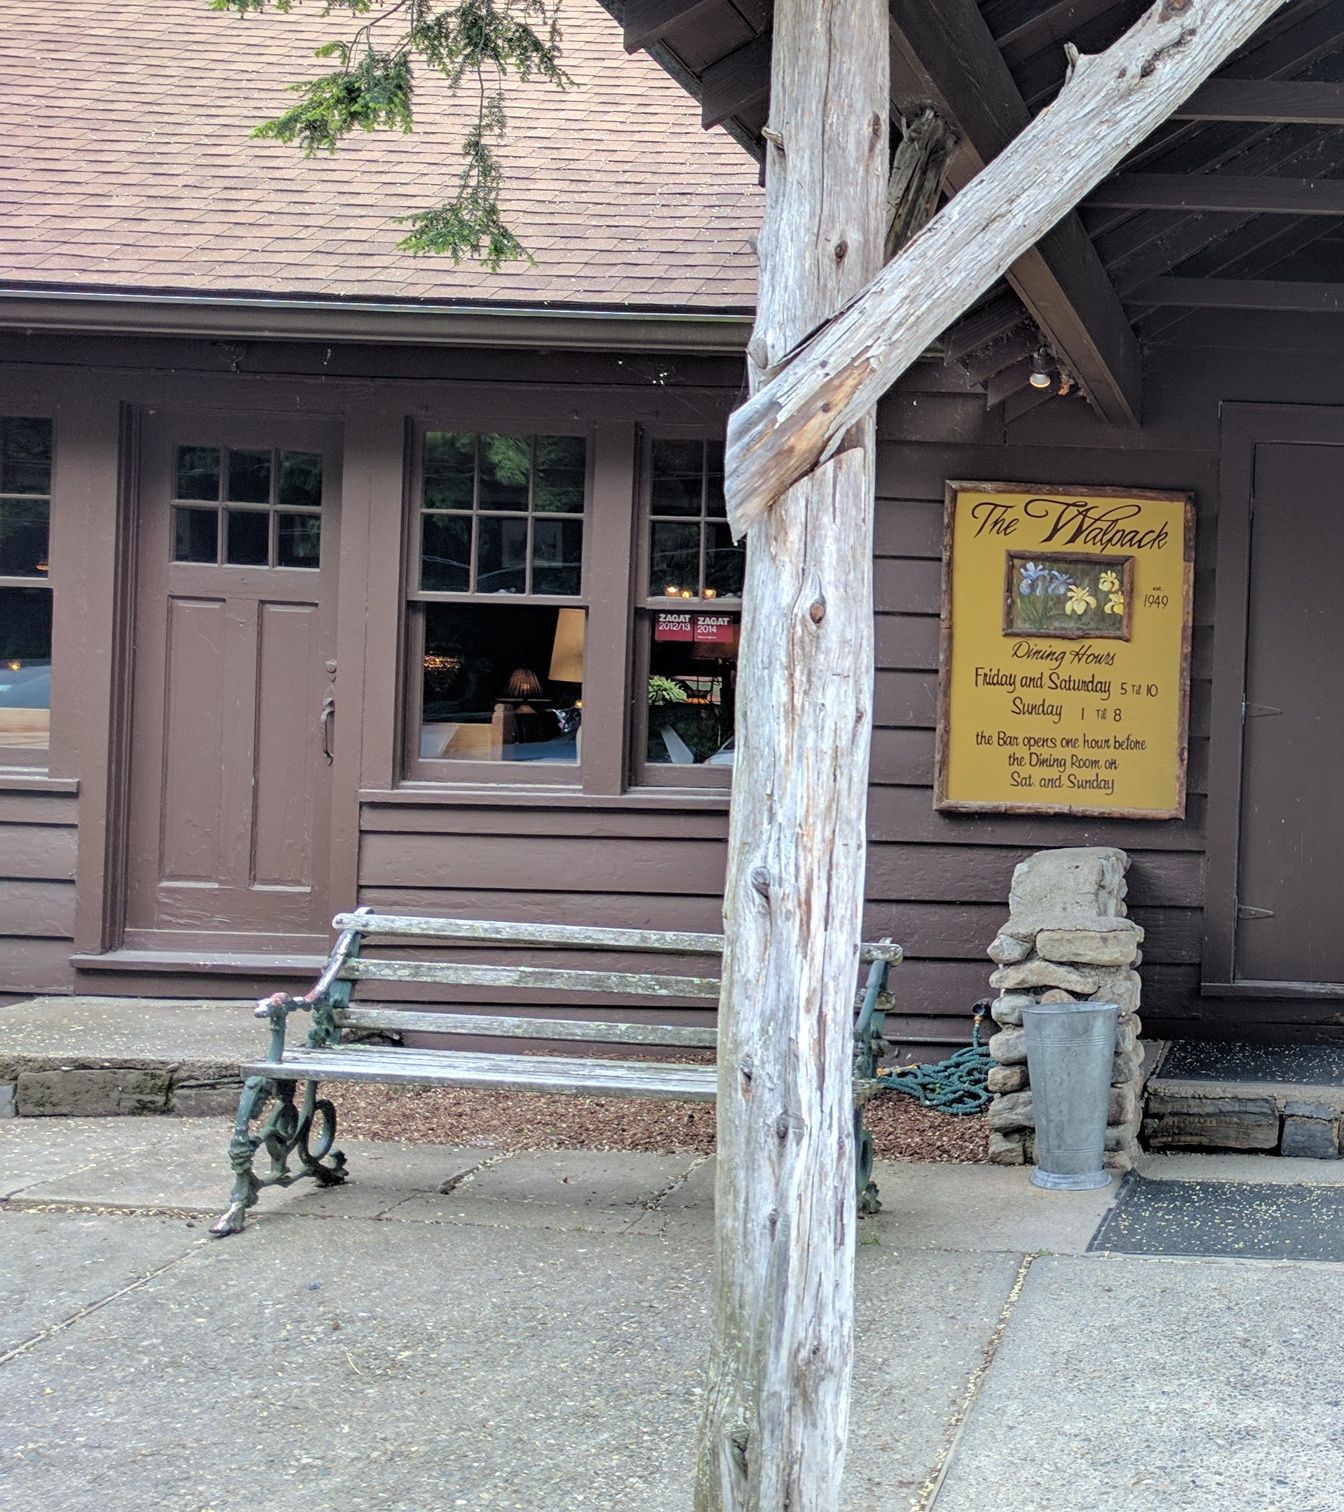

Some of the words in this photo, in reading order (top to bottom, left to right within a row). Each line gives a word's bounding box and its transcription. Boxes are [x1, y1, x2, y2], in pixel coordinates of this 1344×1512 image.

[971, 502, 1020, 538] The
[1023, 498, 1169, 553] Walpack
[1143, 594, 1169, 609] 1949
[658, 622, 691, 631] 2012/13
[659, 614, 691, 623] ZAGAT
[697, 617, 730, 625] ZAGAT
[697, 625, 717, 633] 2014
[1011, 640, 1066, 670] Dining
[1070, 645, 1117, 666] Hours
[975, 667, 1017, 693] Friday
[1020, 672, 1044, 689] and
[1048, 672, 1112, 701] Saturday
[1120, 682, 1128, 696] 5
[1146, 683, 1159, 697] 10
[1011, 696, 1063, 724] Sunday
[1113, 708, 1122, 722] 8
[976, 731, 994, 746] the
[997, 731, 1019, 747] Bar
[1022, 735, 1057, 752] opens
[1060, 737, 1080, 749] one
[1083, 733, 1111, 750] hour
[1114, 734, 1147, 751] before
[1008, 752, 1027, 767] the
[1029, 752, 1067, 773] Dining
[1071, 754, 1101, 769] Room
[1104, 758, 1118, 770] on
[1039, 773, 1064, 789] and
[1067, 774, 1115, 795] Sunday
